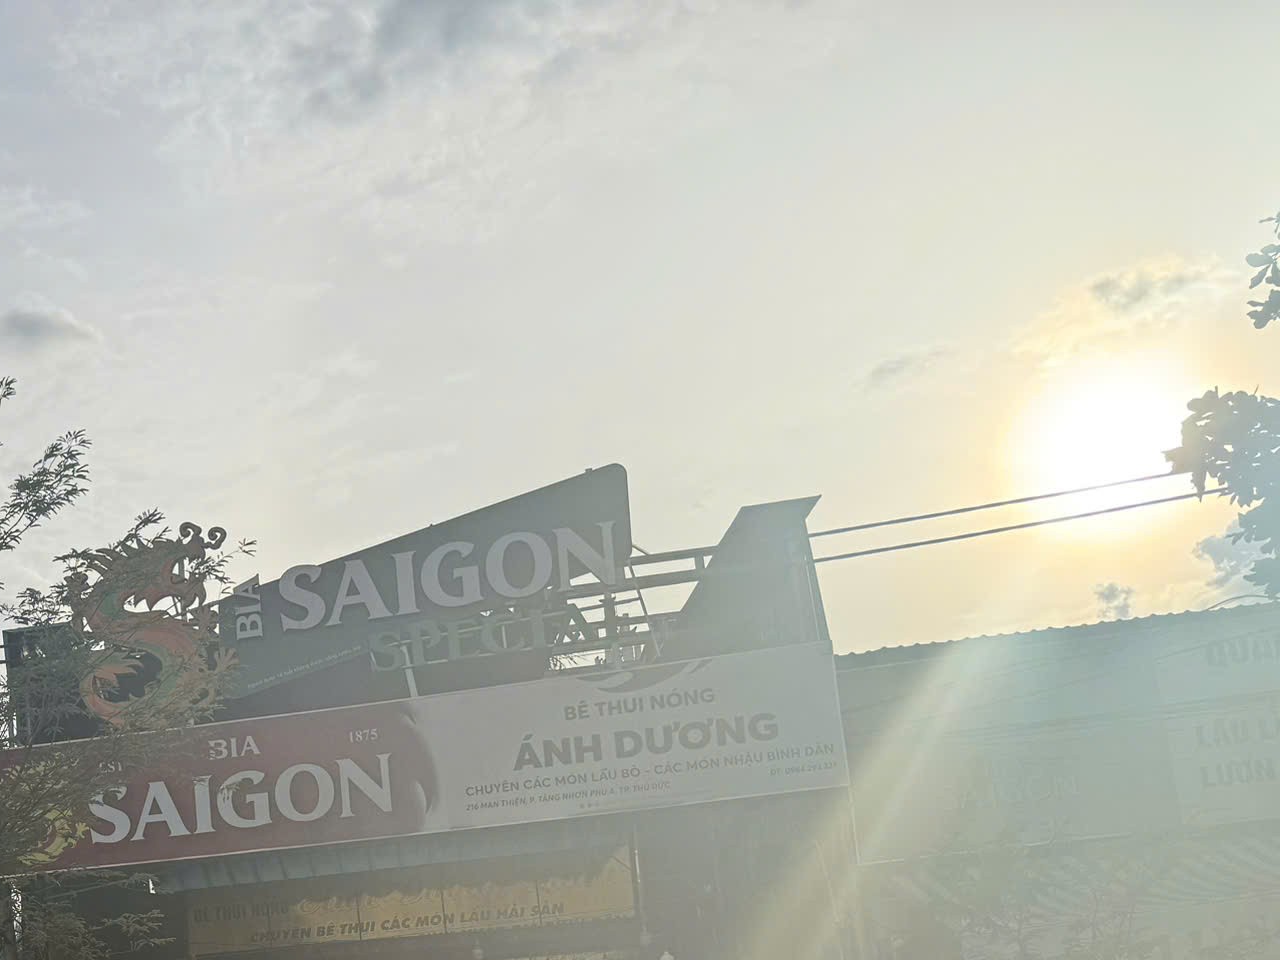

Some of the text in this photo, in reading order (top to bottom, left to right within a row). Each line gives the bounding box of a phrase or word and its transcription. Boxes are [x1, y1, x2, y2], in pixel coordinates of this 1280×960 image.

[278, 520, 618, 633] SAIGON
[235, 573, 263, 642] BIA
[595, 696, 645, 718] THUI
[650, 687, 715, 712] NÓNG
[207, 735, 261, 761] BIA
[348, 727, 379, 744] 1875
[513, 711, 780, 772] ÁNH DƯƠNG
[465, 780, 519, 798] CHUYÊN
[523, 775, 551, 790] CÁC
[621, 765, 641, 779] BÒ
[654, 761, 683, 775] CÁC
[724, 749, 763, 767] NHẬU
[767, 746, 801, 761] BÌNH
[88, 751, 393, 845] SAIGON
[466, 801, 479, 811] 216
[317, 921, 335, 937] BÊ
[339, 920, 376, 936] THUI
[381, 912, 411, 931] CÁC
[416, 908, 455, 928] MÓN
[497, 901, 525, 920] HẢI
[530, 898, 565, 917] SẢN
